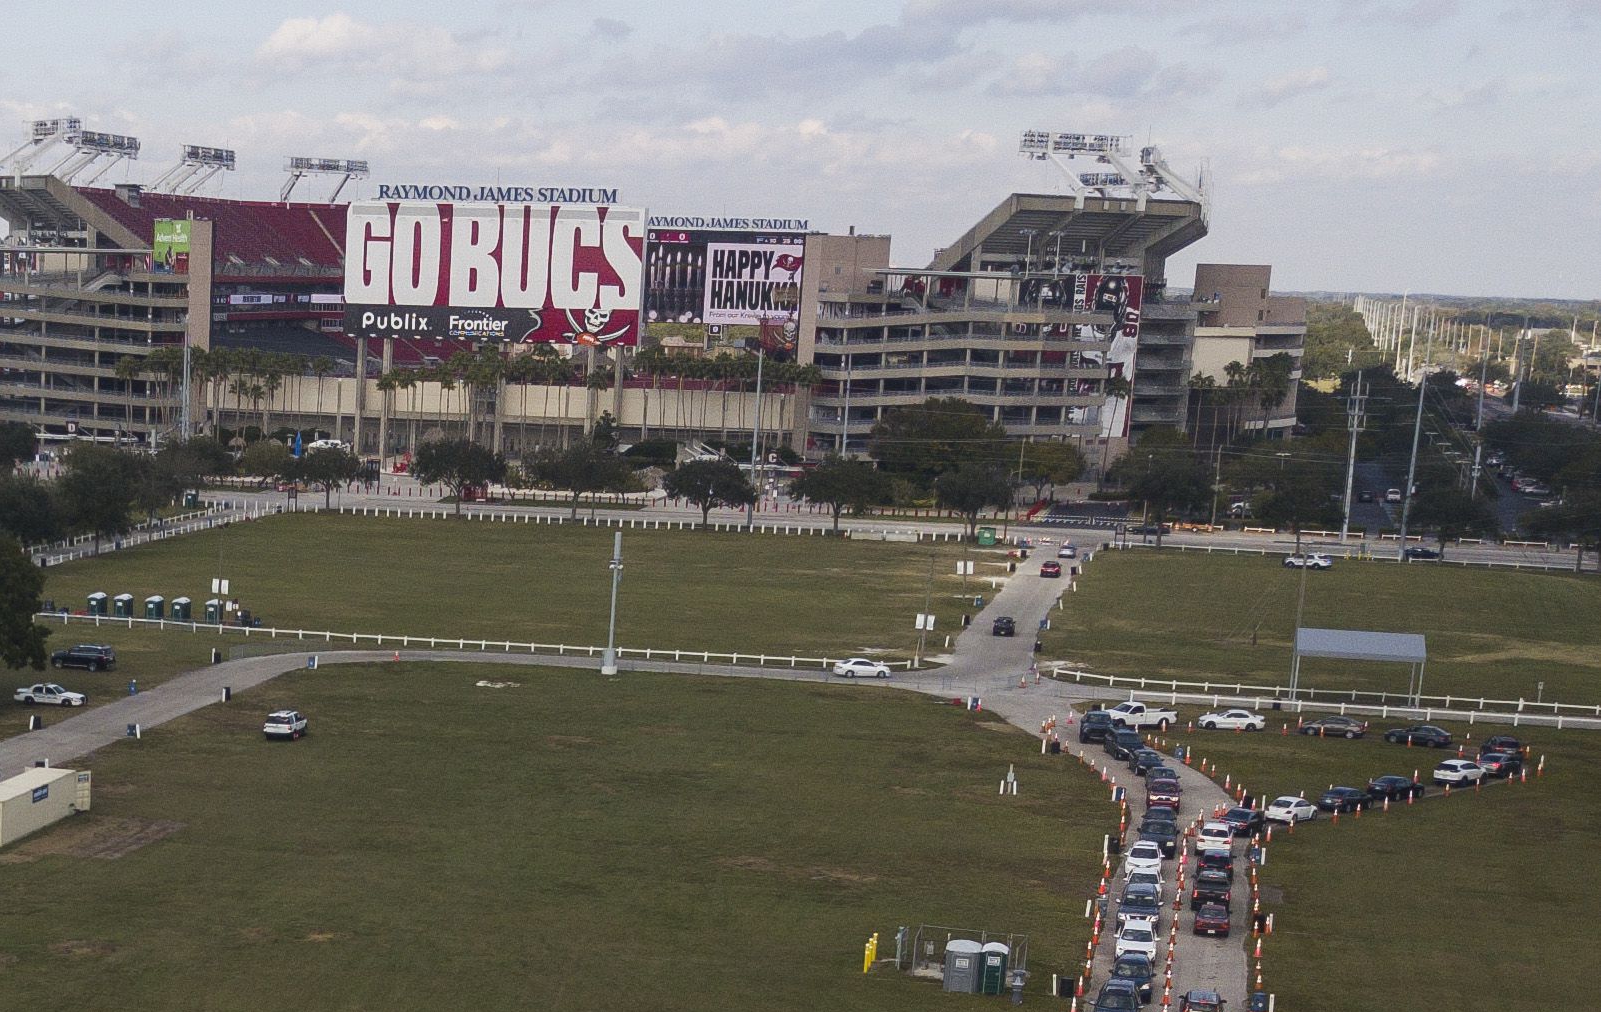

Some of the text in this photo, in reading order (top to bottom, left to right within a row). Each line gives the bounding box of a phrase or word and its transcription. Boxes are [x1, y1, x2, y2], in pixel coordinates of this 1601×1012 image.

[378, 184, 619, 204] RAYMOND JAMES STADIUM
[647, 216, 808, 230] AYMOND JAMES STADIUM
[344, 202, 645, 310] GO BUCS
[711, 249, 775, 280] HAPPY
[362, 312, 428, 331] Publix
[449, 315, 508, 331] Frontier
[67, 423, 76, 433] D
[768, 453, 778, 463] C
